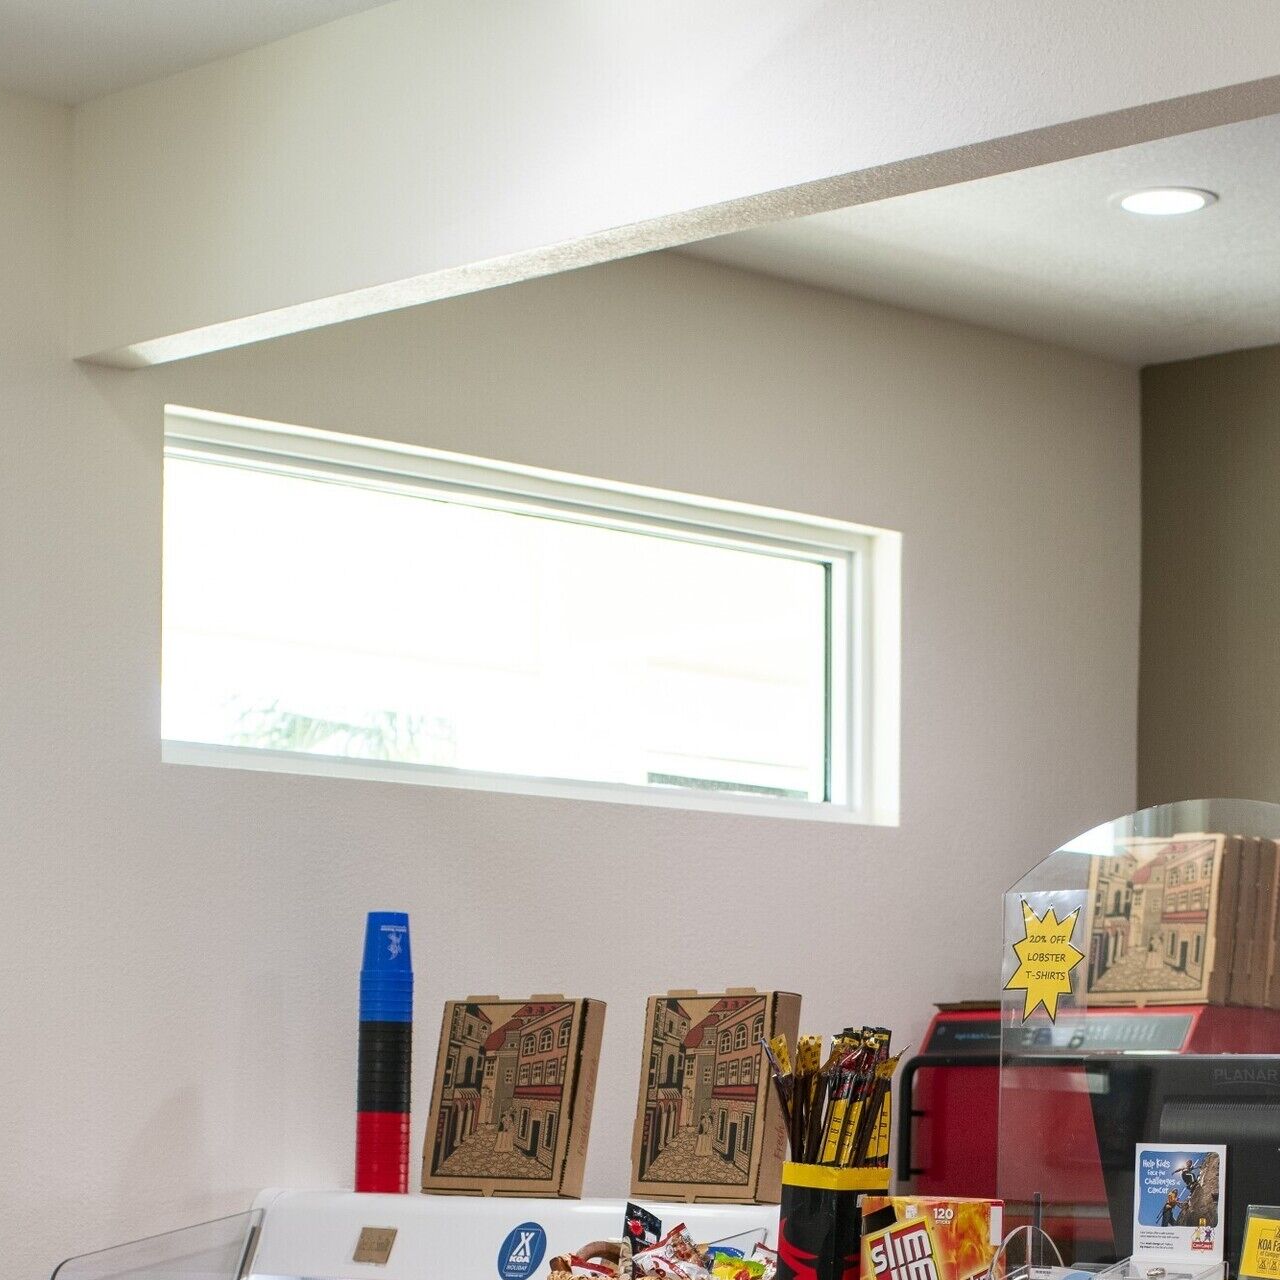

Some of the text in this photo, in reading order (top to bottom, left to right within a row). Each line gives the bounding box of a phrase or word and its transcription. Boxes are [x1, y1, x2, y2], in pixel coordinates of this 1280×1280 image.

[1029, 935, 1066, 944] 20% OFF
[1027, 952, 1066, 962] LOBSTER
[1026, 970, 1066, 980] T-SHIRTS
[1214, 1068, 1278, 1081] PLANAR
[1142, 1158, 1171, 1169] Help Kids
[1144, 1177, 1176, 1187] Challenges
[933, 1208, 954, 1220] 120
[1257, 1238, 1272, 1252] KOA
